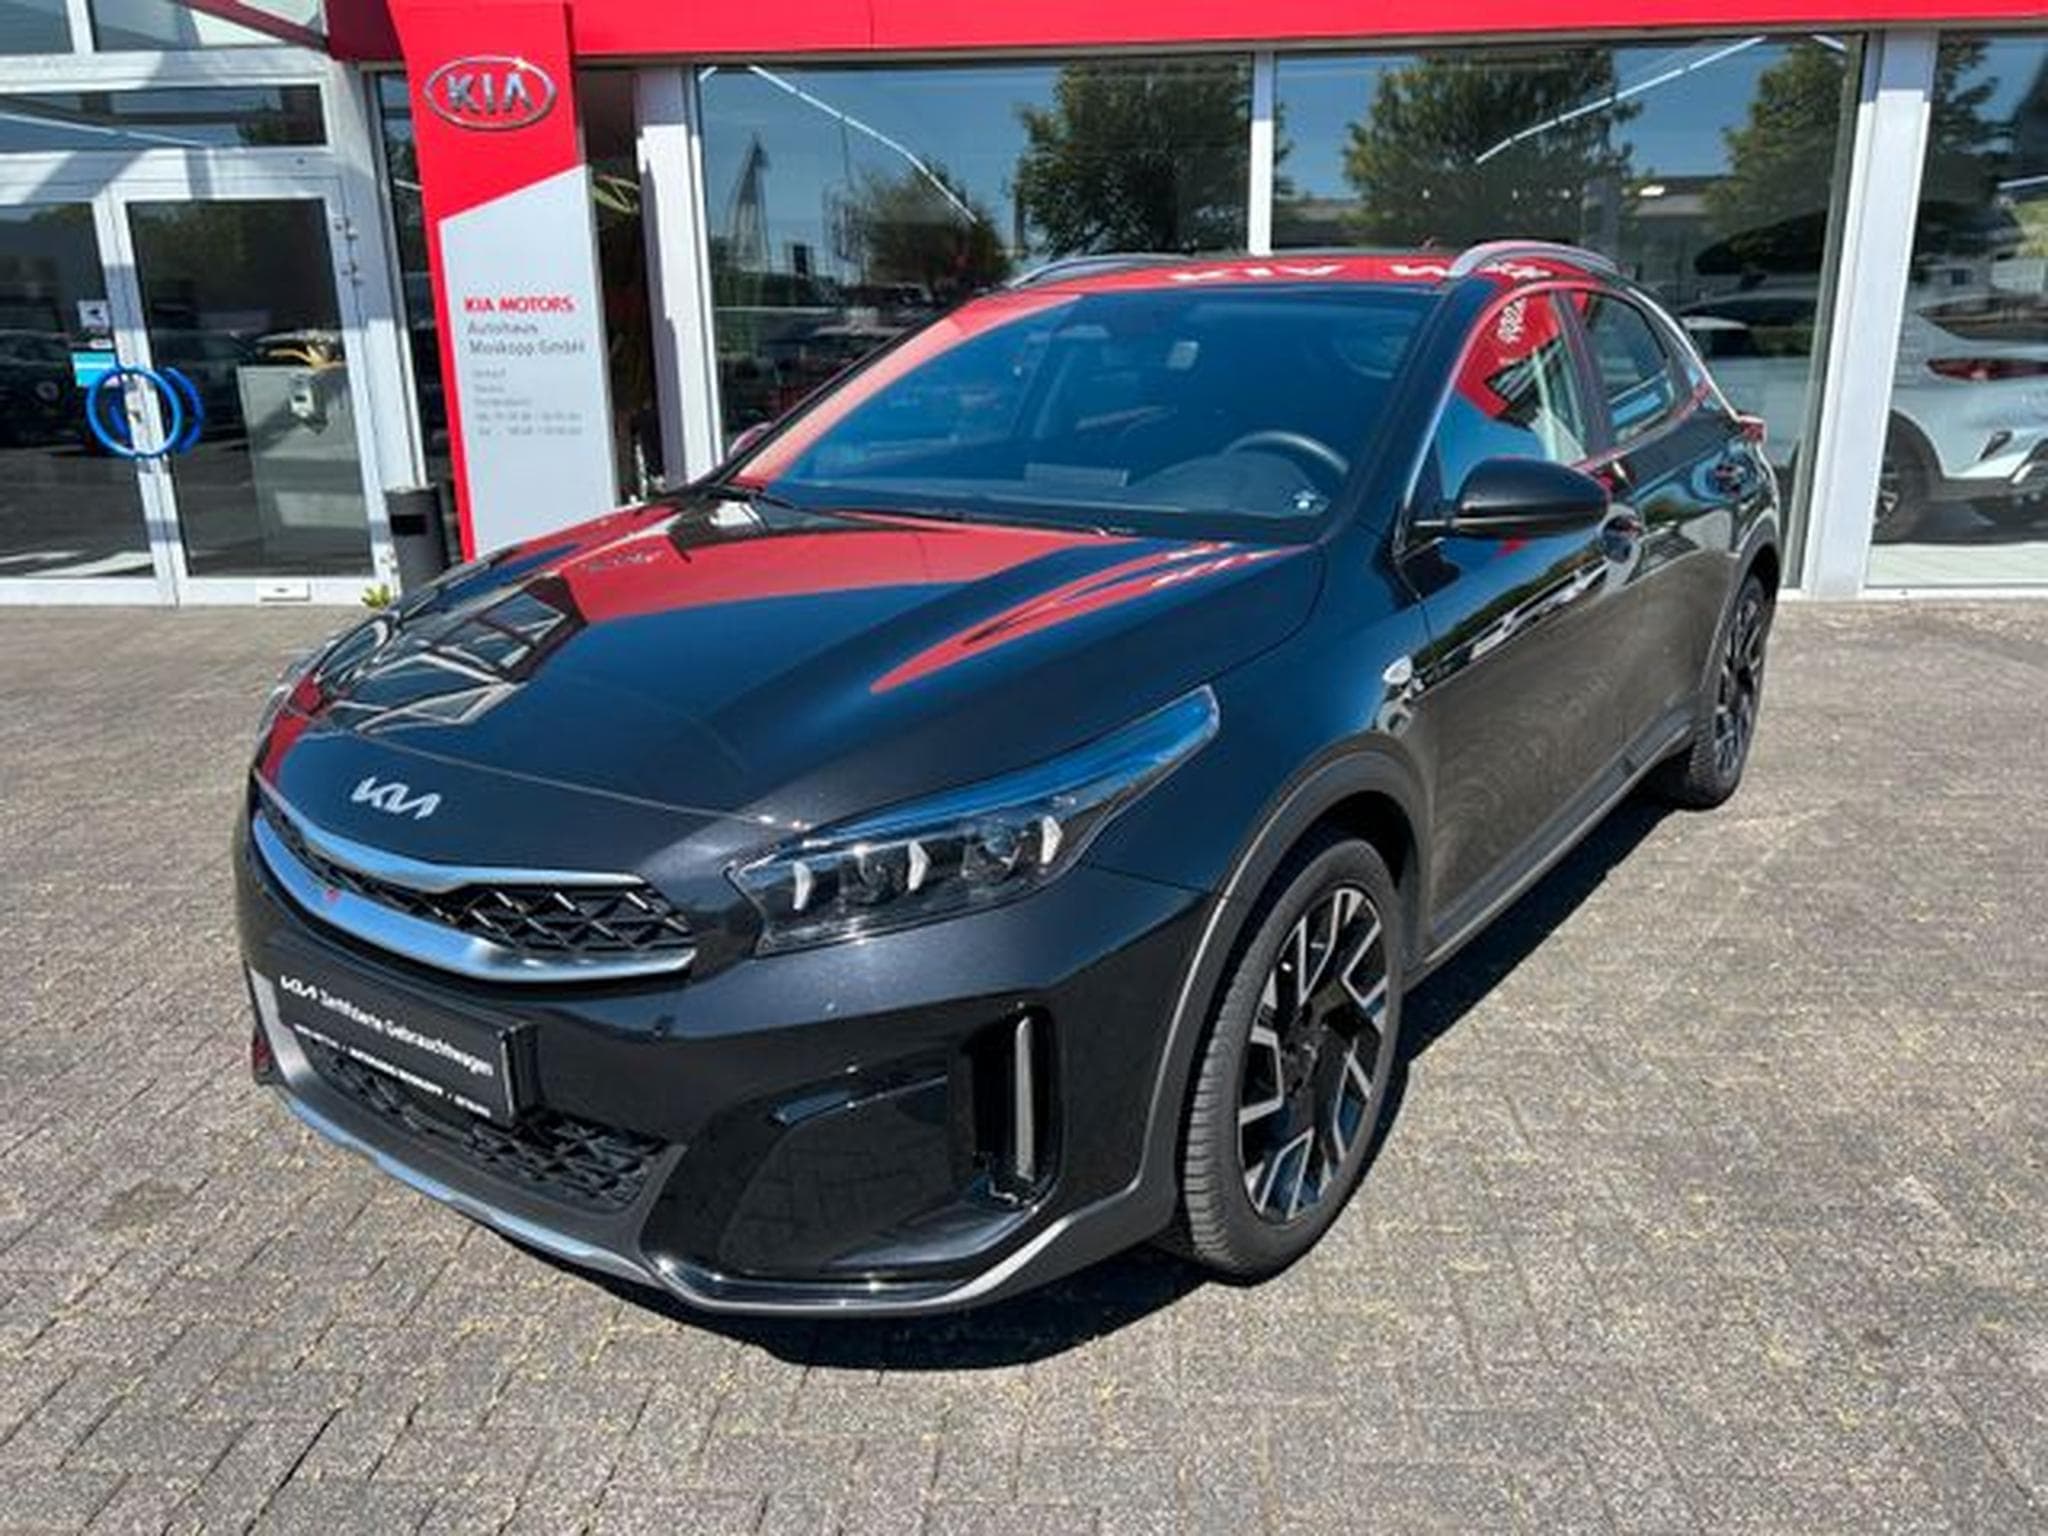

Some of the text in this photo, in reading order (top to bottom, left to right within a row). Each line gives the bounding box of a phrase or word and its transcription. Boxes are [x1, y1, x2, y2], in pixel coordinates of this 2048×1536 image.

[447, 71, 533, 115] KIA
[464, 294, 576, 314] KIA MOTORS
[351, 776, 441, 820] KIA
[280, 974, 317, 1000] KIA
